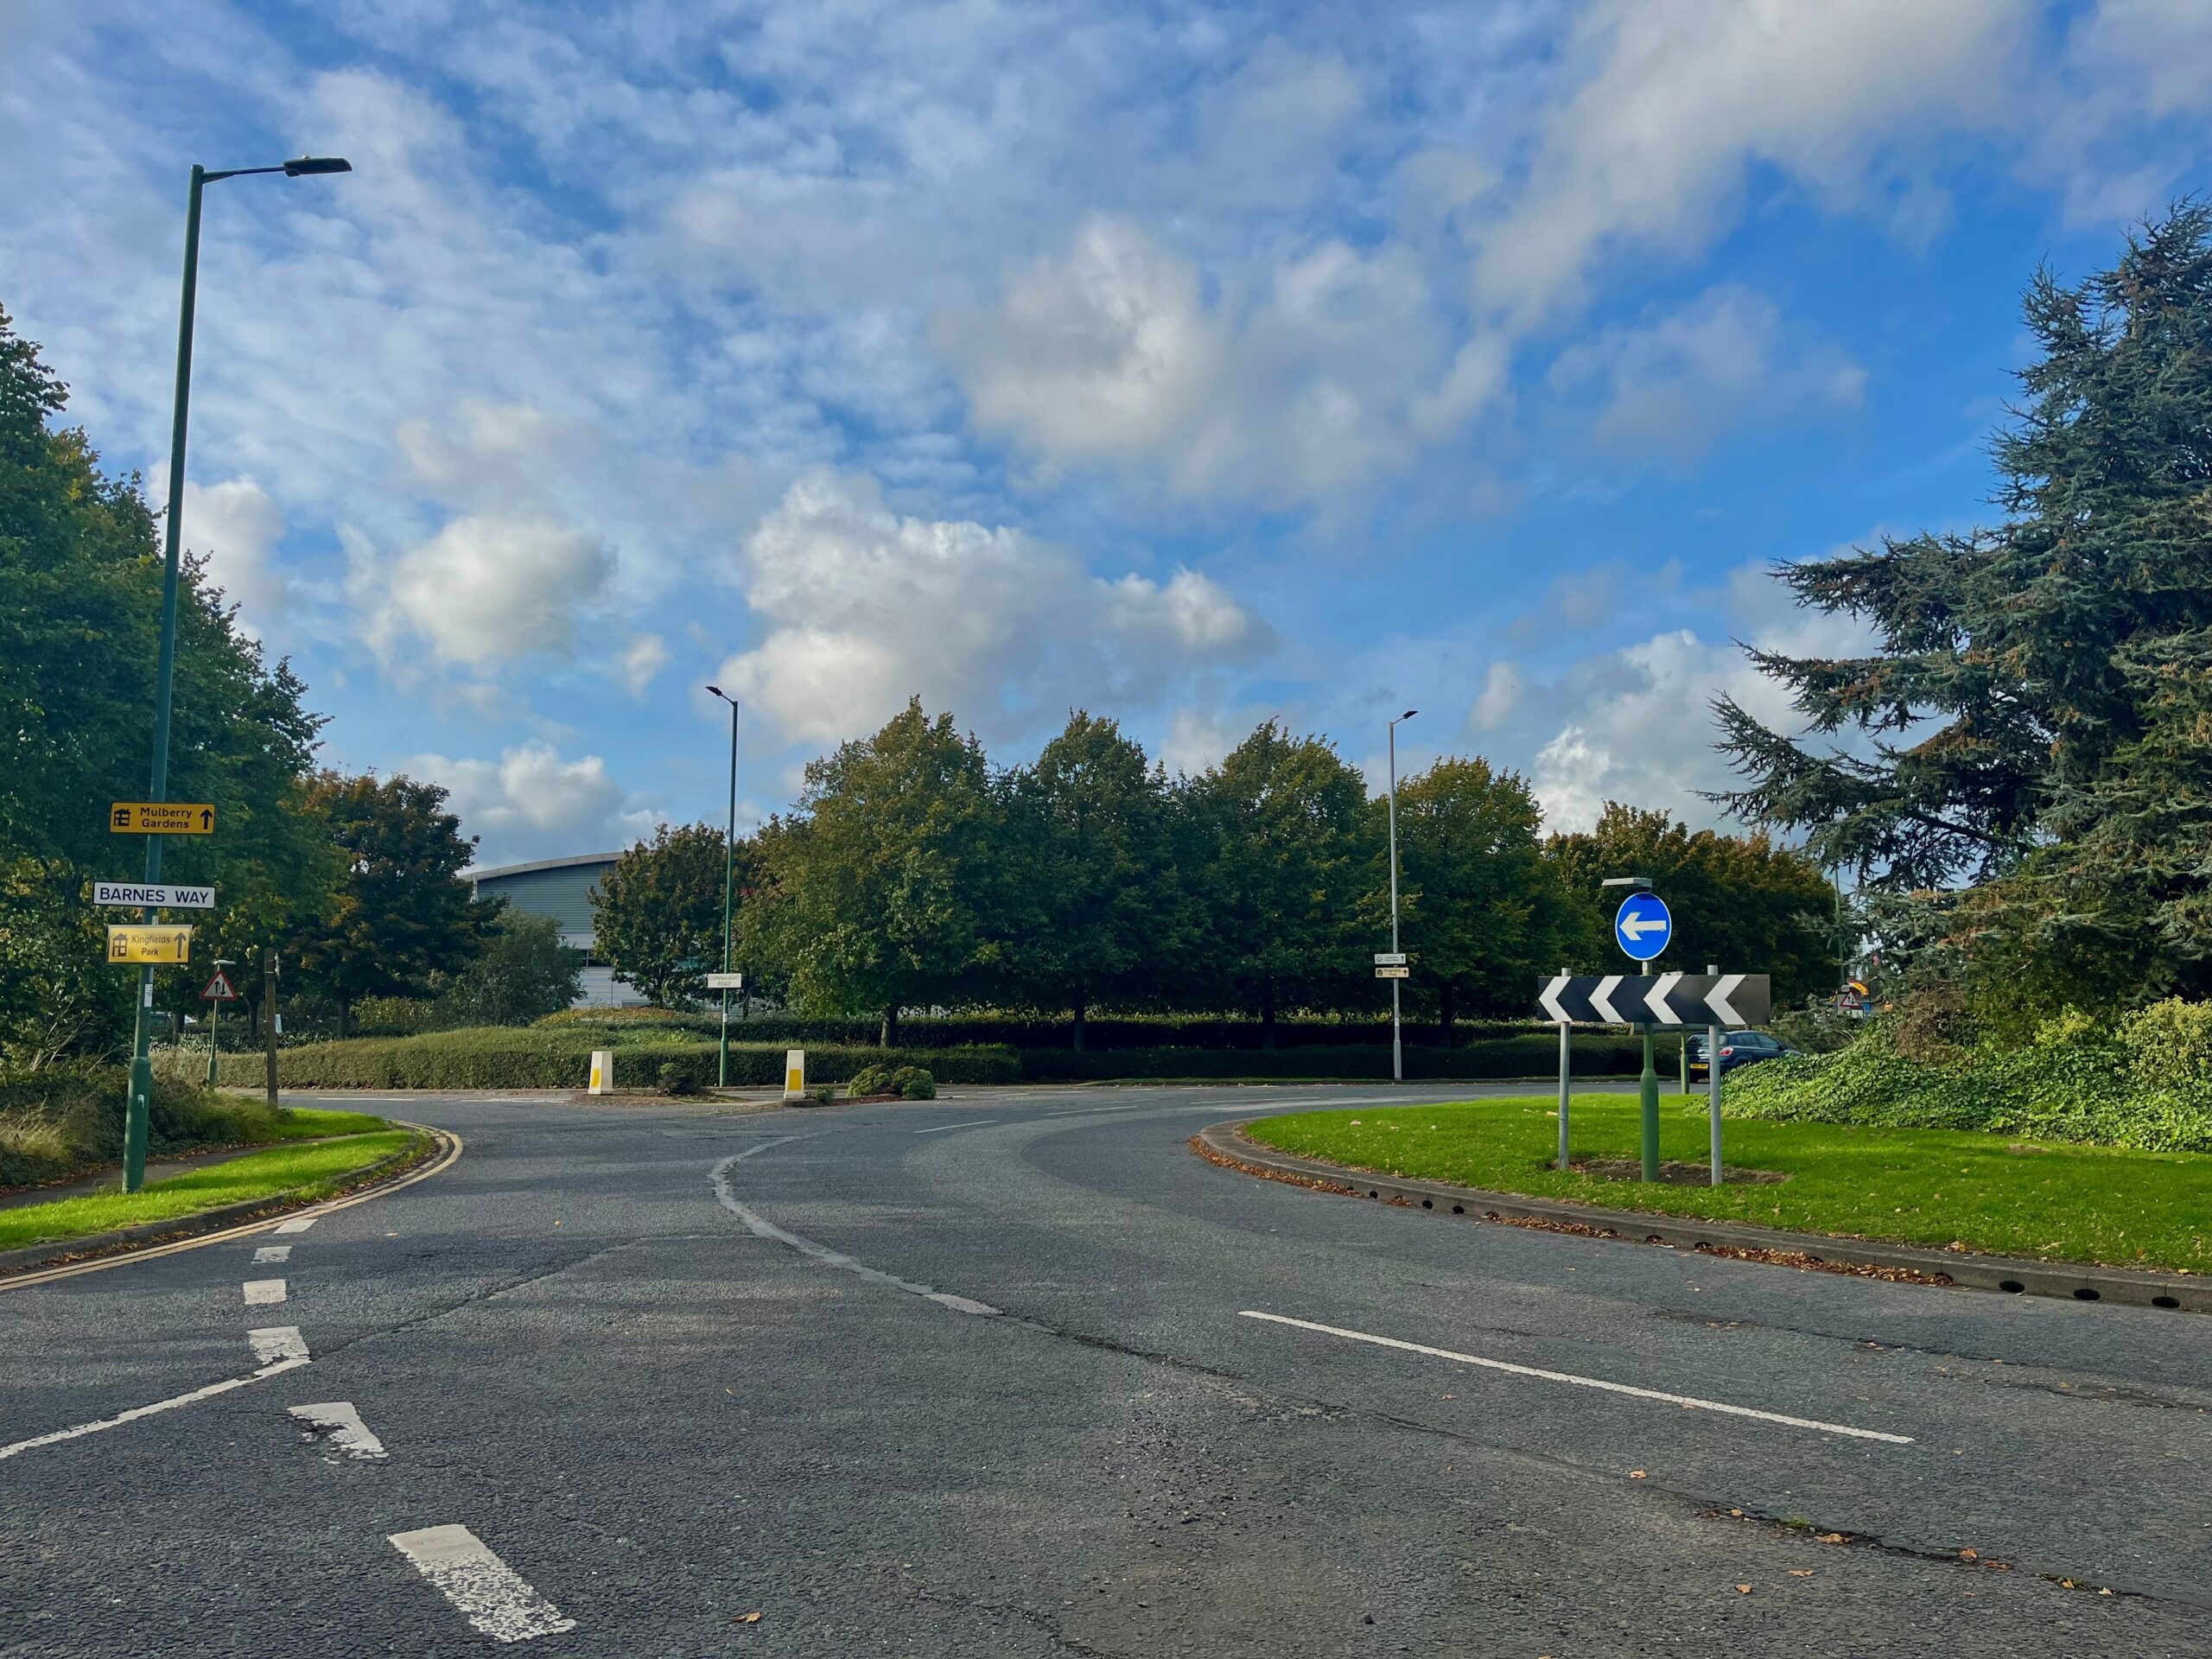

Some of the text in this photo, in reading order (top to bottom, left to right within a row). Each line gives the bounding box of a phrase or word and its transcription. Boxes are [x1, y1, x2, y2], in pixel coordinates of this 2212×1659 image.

[140, 807, 193, 819] Mulberry
[142, 818, 189, 829] Gardens
[99, 887, 209, 904] BARNES WAY
[131, 935, 171, 945] Kingfields
[141, 947, 159, 957] Park
